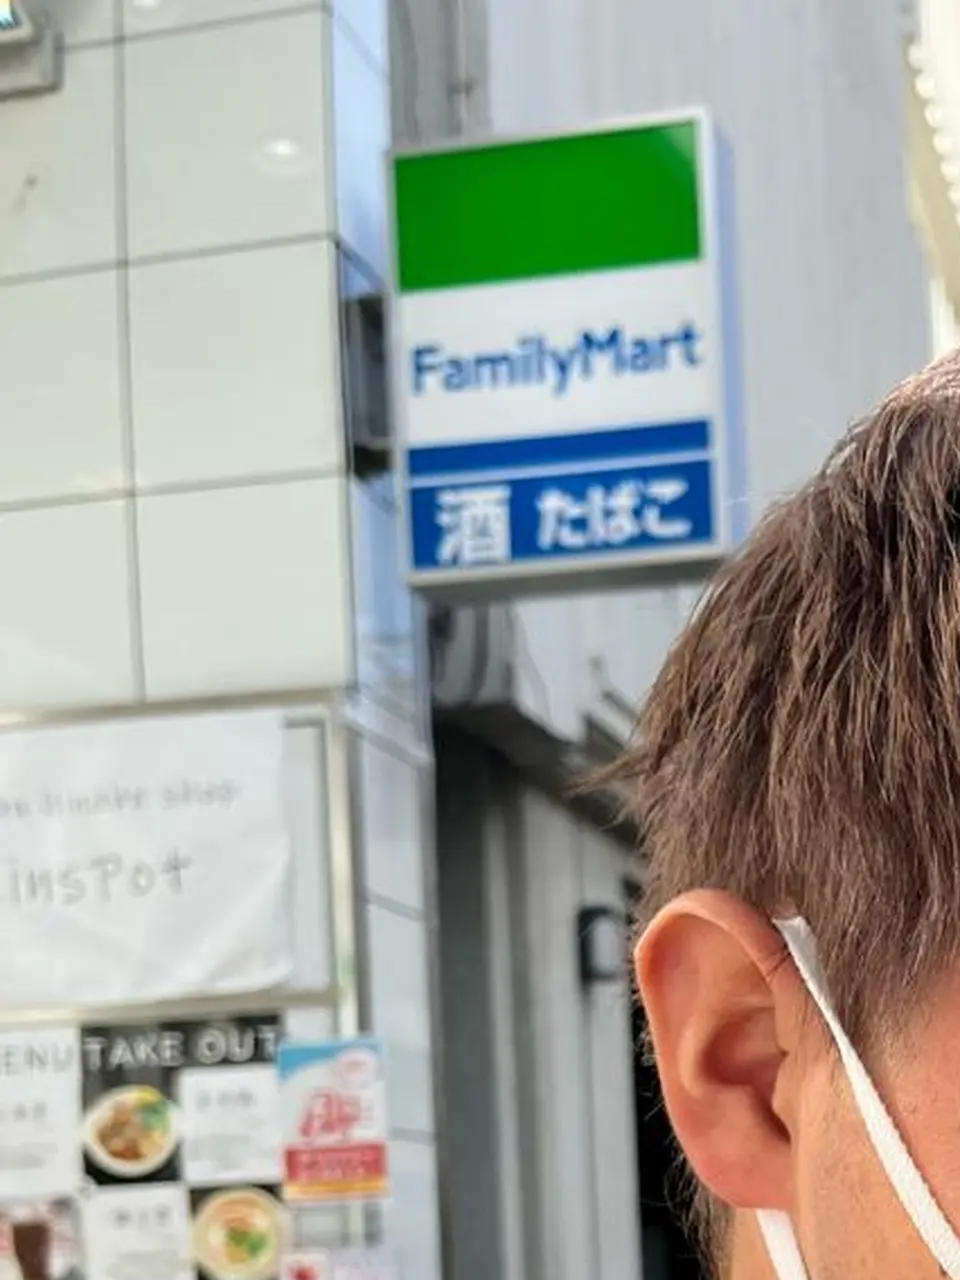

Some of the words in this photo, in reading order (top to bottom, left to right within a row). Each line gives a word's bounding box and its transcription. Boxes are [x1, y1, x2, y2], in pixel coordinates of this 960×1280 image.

[412, 324, 701, 395] FamilyMart
[436, 484, 511, 566] 酒
[538, 479, 692, 549] たばこ
[0, 1039, 75, 1078] ENU
[82, 1029, 185, 1072] TAKE
[197, 1023, 282, 1064] OUT
